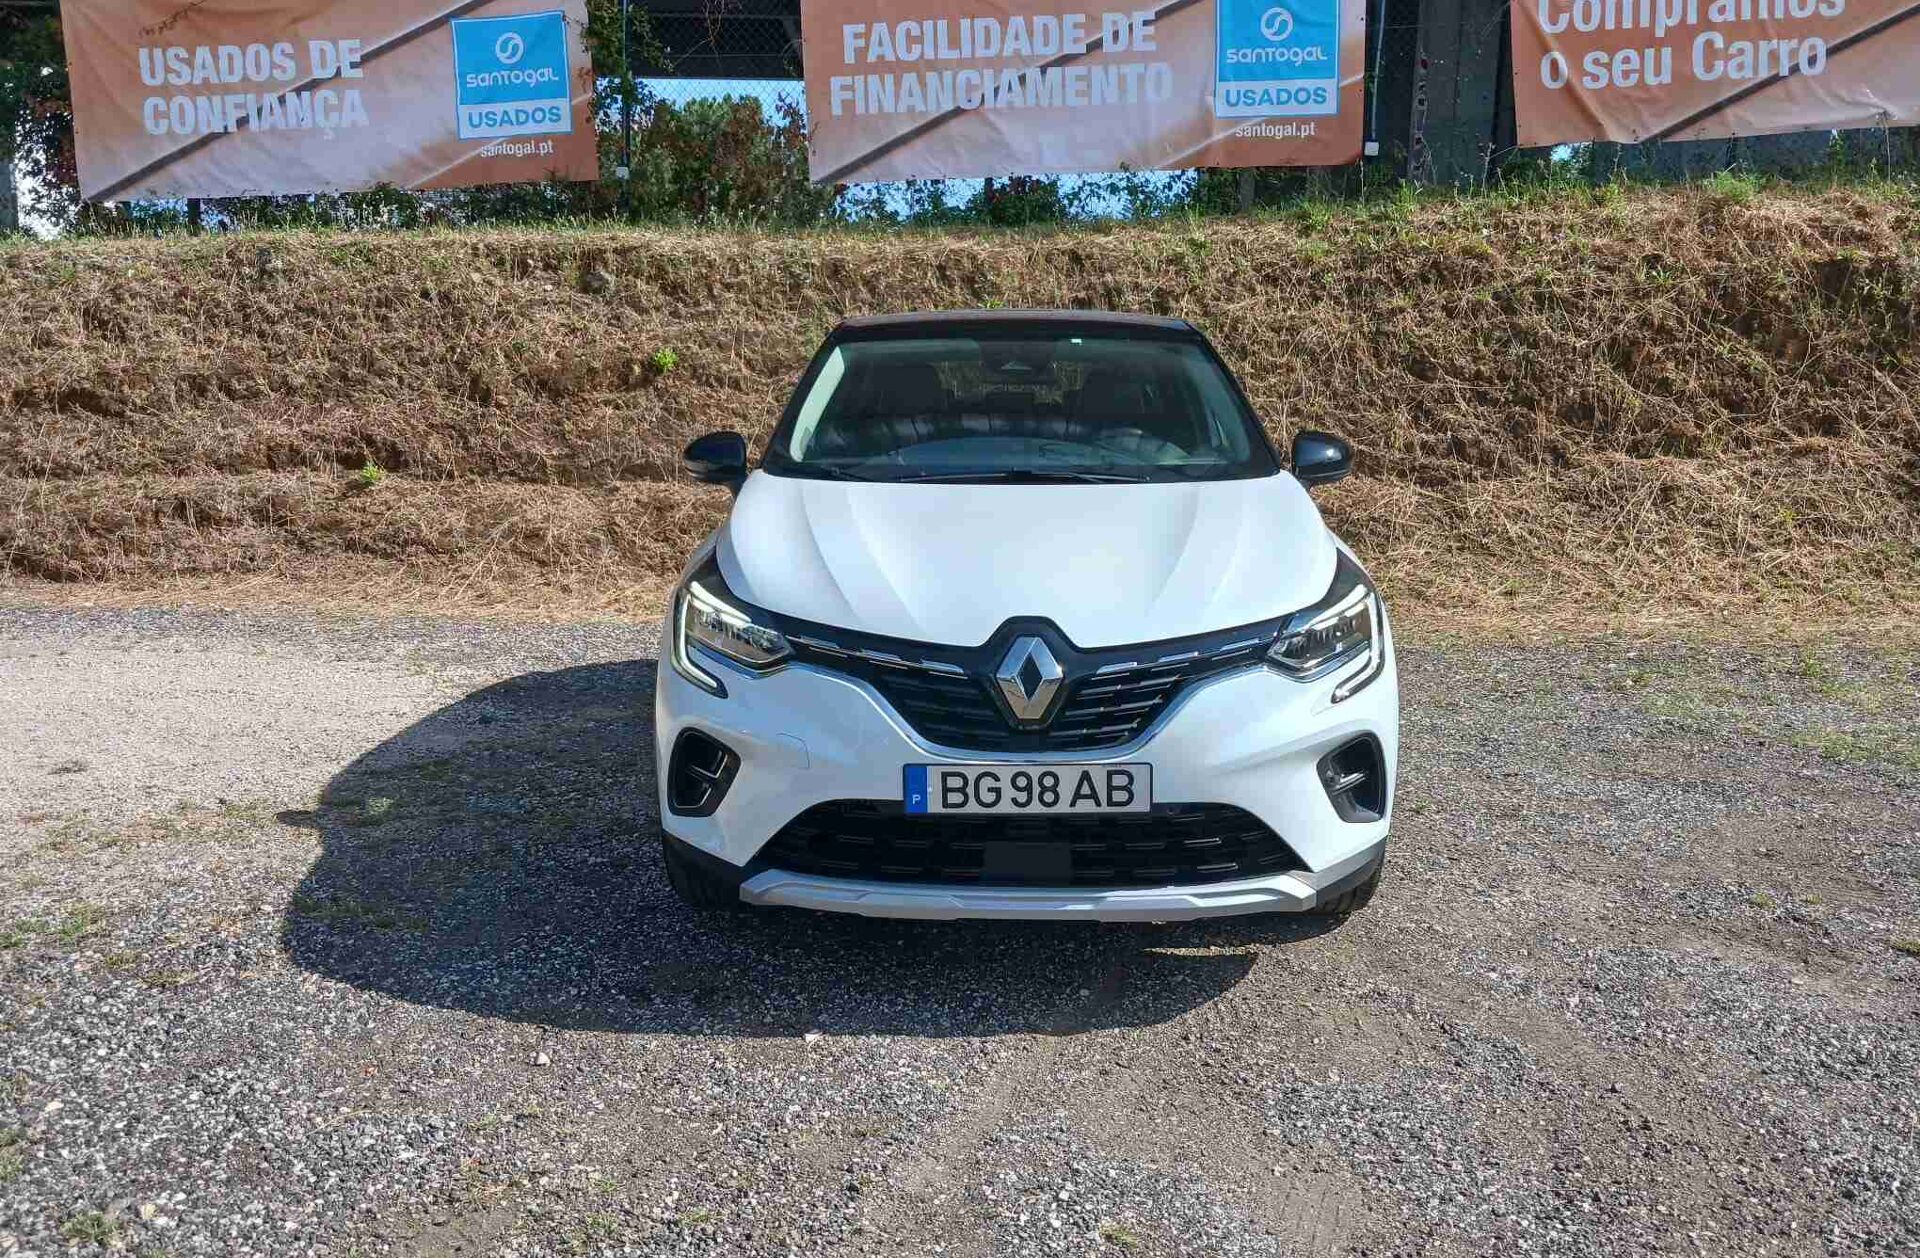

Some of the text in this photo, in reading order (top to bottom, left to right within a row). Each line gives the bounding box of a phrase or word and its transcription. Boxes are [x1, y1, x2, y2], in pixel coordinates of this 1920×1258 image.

[842, 11, 1157, 64] FACILIDADE DE
[139, 39, 364, 87] USADOS DE
[1540, 31, 1827, 90] o seu Carro
[830, 62, 1174, 117] FINANCIAMENTO
[1225, 86, 1328, 107] USADOS
[143, 88, 370, 140] CONFIANÇA
[468, 106, 562, 129] USADOS
[1236, 121, 1316, 139] santogal.pt
[480, 139, 554, 158] santogal.pt
[912, 794, 921, 805] P
